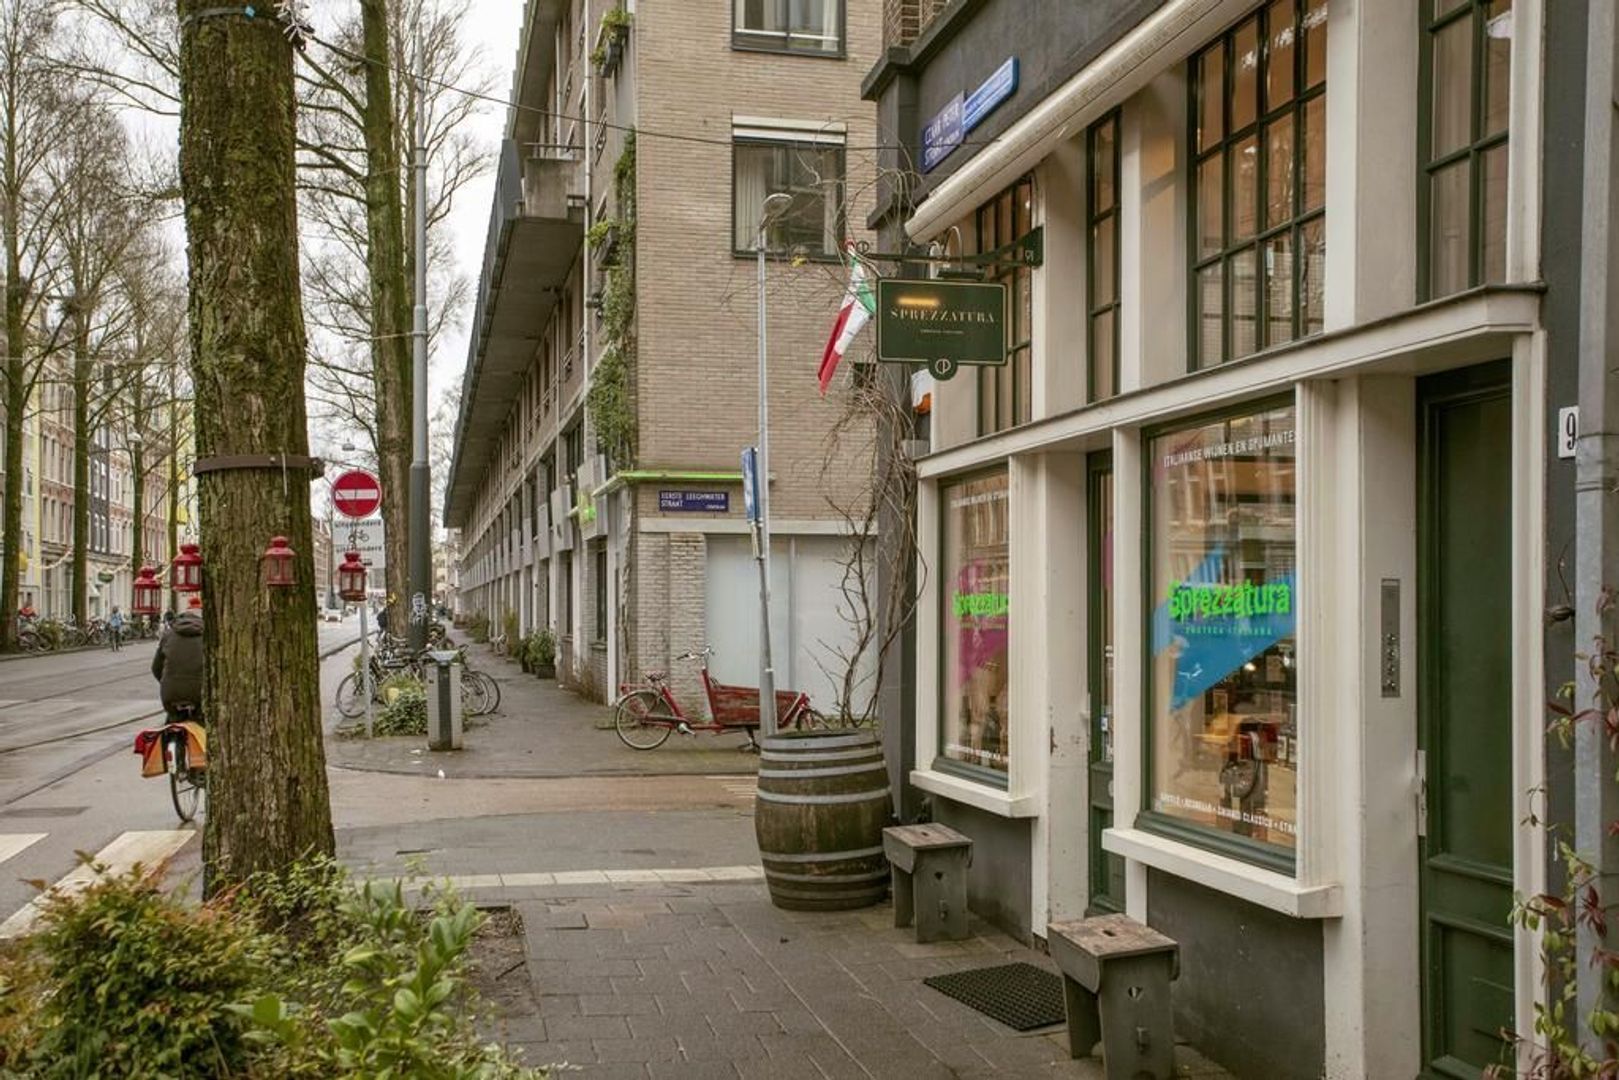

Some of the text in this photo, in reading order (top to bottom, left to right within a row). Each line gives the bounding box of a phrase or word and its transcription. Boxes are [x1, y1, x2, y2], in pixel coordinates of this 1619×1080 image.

[891, 308, 994, 323] SPREZZATURA
[1566, 412, 1576, 450] 9
[1167, 579, 1291, 624] Sprezzatura
